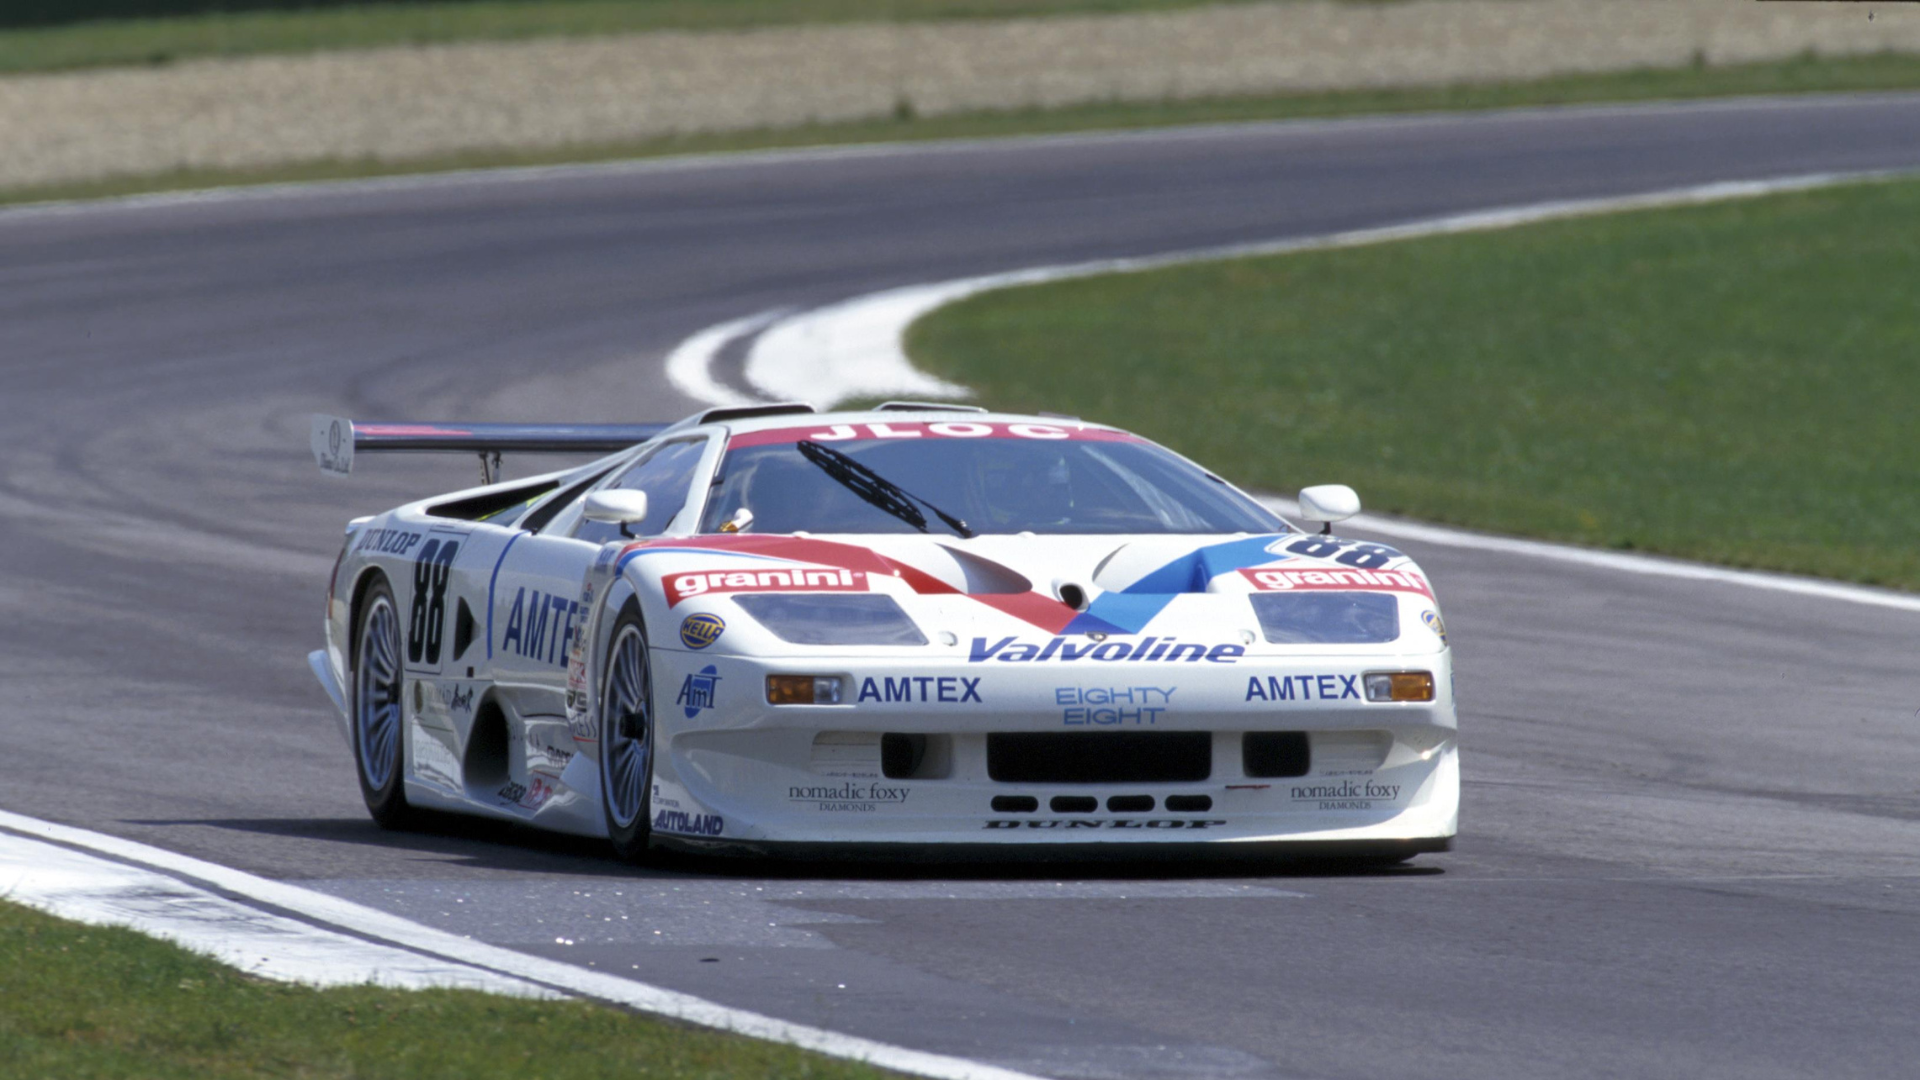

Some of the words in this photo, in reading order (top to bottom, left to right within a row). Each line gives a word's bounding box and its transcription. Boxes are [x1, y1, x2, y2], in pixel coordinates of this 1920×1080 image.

[809, 422, 1071, 441] JLOC
[356, 528, 421, 555] DUNLOP
[674, 569, 854, 598] granini
[1254, 567, 1423, 590] granini
[408, 538, 459, 665] 88
[683, 619, 723, 641] HELLA
[967, 636, 1246, 664] Valvoline
[858, 676, 983, 702] AMTEX
[1055, 686, 1178, 706] EIGHTY
[1245, 674, 1361, 702] AMTEX
[1063, 707, 1166, 725] EIGHT
[789, 782, 866, 800] nomadic
[869, 782, 911, 803] foxy
[1291, 780, 1360, 798] nomadic
[1364, 779, 1401, 800] foxy
[819, 802, 877, 812] DIAMONDS
[1319, 801, 1372, 811] DIAMONDS
[654, 809, 724, 836] AUTOLAND
[981, 819, 1227, 829] DUNLOP
